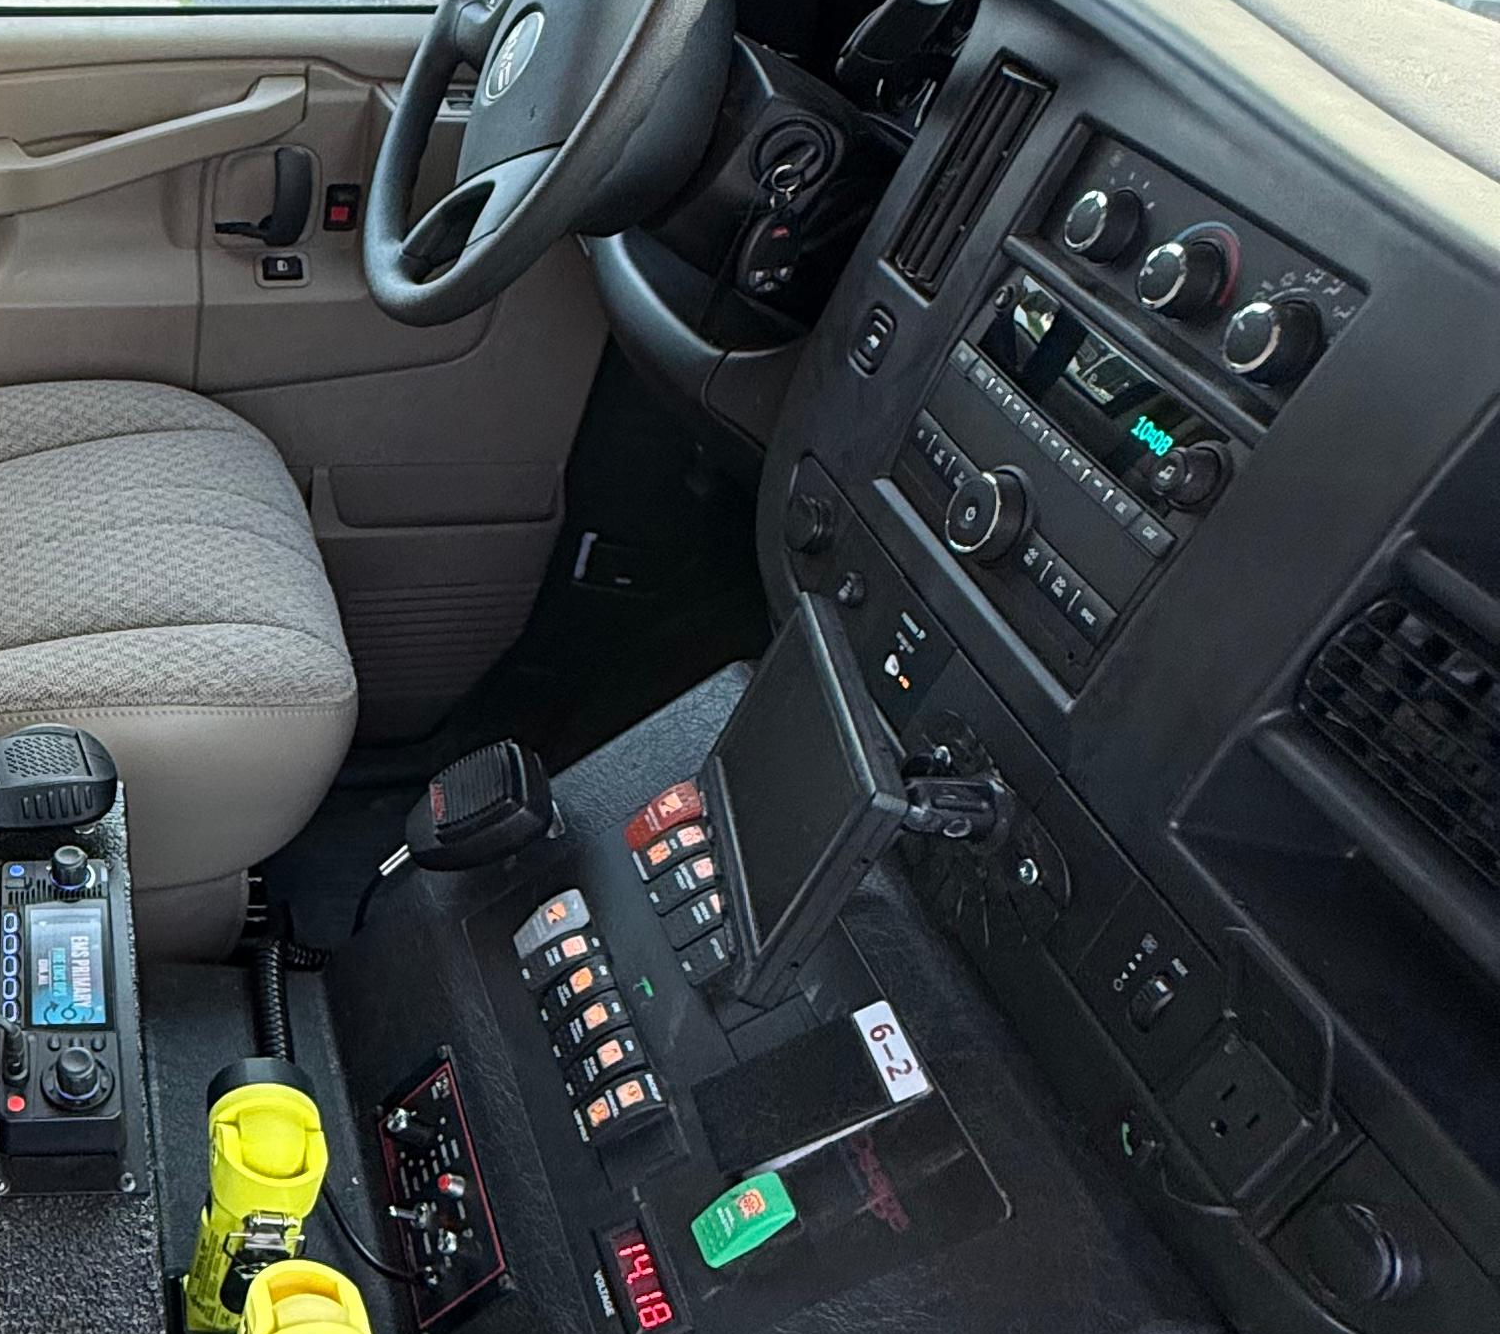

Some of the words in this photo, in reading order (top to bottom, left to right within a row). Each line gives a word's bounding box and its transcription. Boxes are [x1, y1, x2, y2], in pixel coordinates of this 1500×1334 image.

[1130, 415, 1174, 457] 10:08
[71, 935, 90, 958] EMS
[71, 958, 92, 1008] PRIMARY
[868, 1021, 914, 1083] 6-2
[605, 1089, 620, 1118] CANCEL
[644, 1073, 662, 1102] BACKUP
[593, 1269, 616, 1317] VOLTAGE
